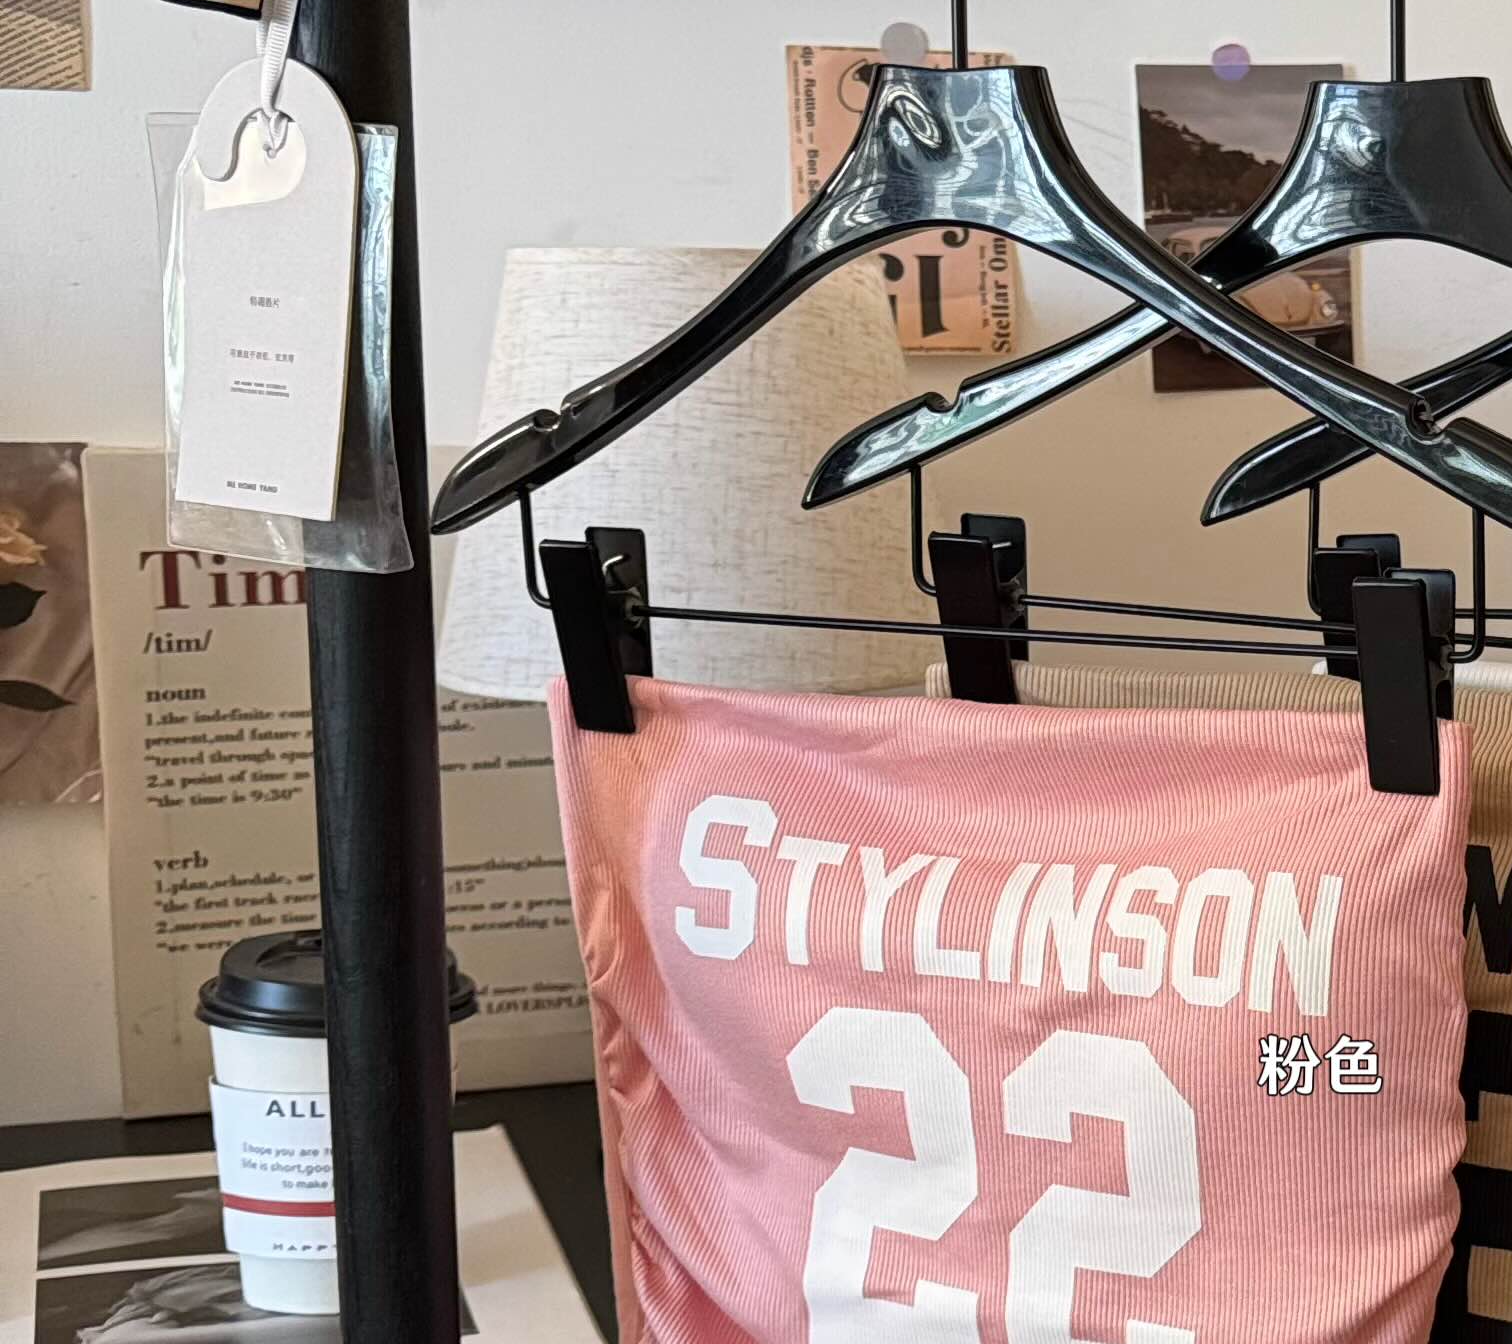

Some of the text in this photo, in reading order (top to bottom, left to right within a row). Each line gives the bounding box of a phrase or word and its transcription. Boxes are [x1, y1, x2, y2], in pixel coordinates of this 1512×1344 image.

[991, 280, 1011, 353] Stellar
[145, 688, 206, 703] noun
[153, 850, 209, 871] verb
[675, 794, 1343, 1017] STYLINSON
[266, 1100, 326, 1118] ALL
